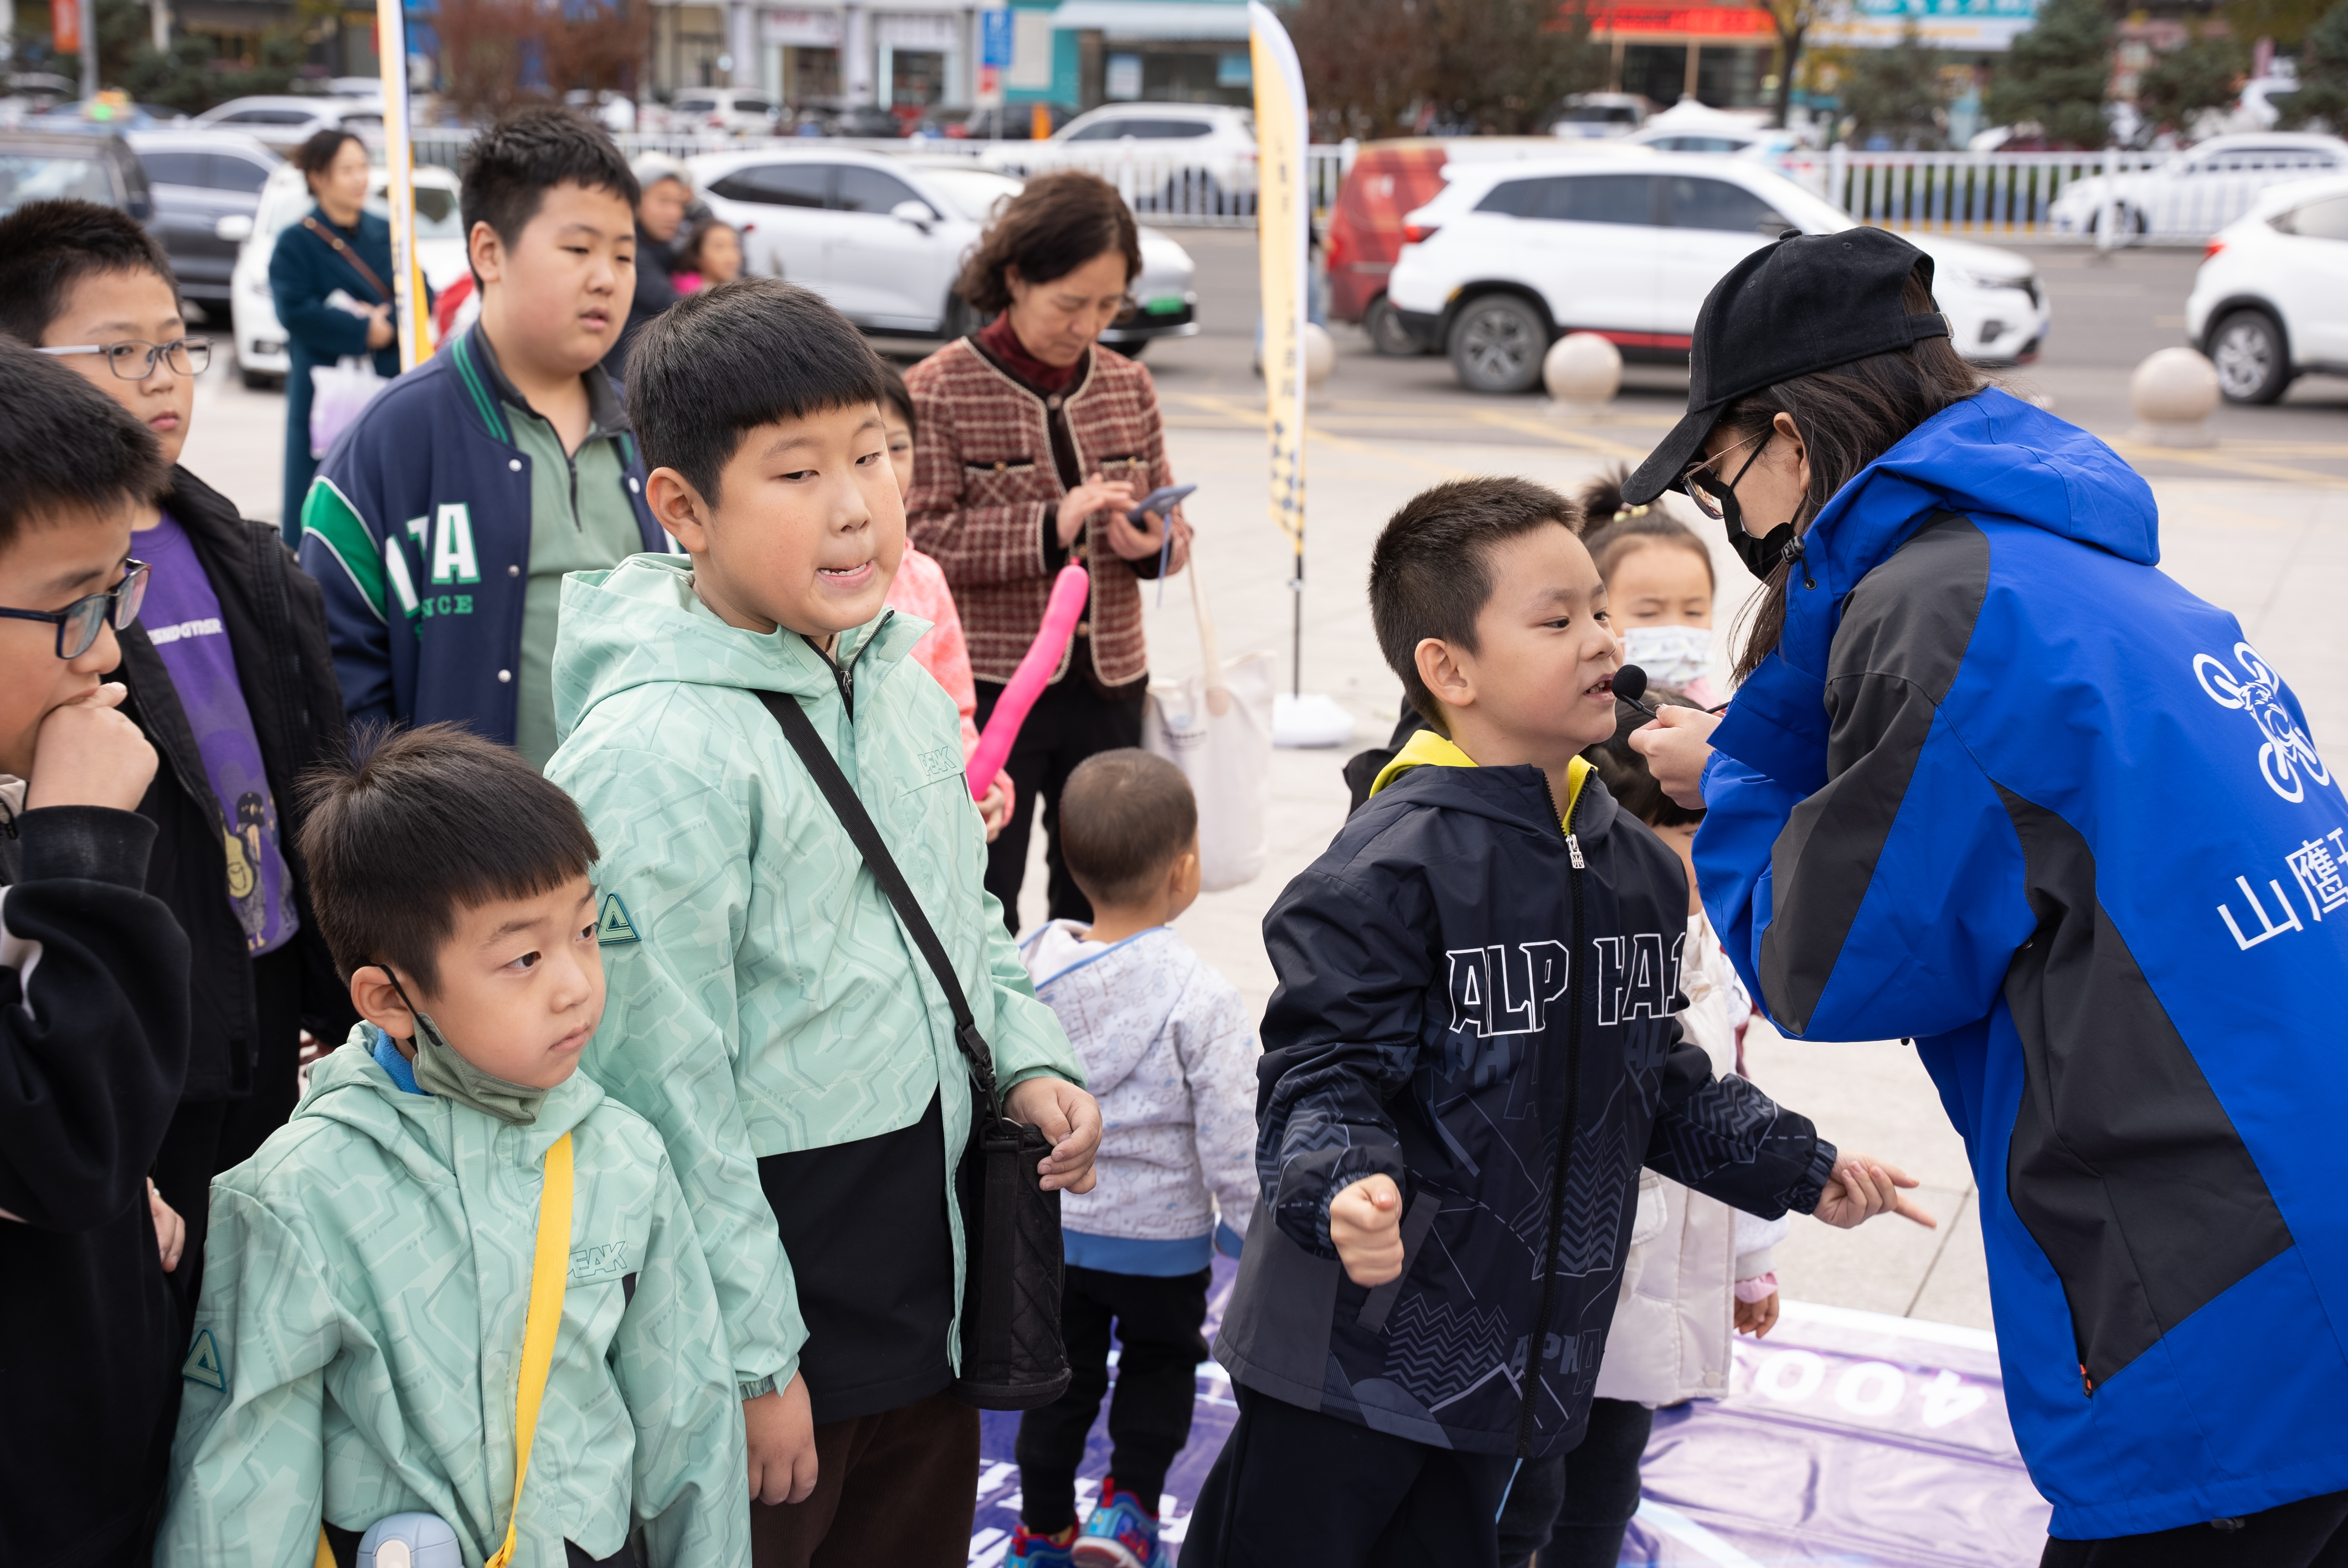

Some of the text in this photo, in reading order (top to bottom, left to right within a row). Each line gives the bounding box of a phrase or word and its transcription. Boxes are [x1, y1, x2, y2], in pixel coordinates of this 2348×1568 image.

[918, 746, 956, 776] PEAK
[567, 1241, 627, 1278] EAK
[1729, 1339, 1988, 1428] 400
